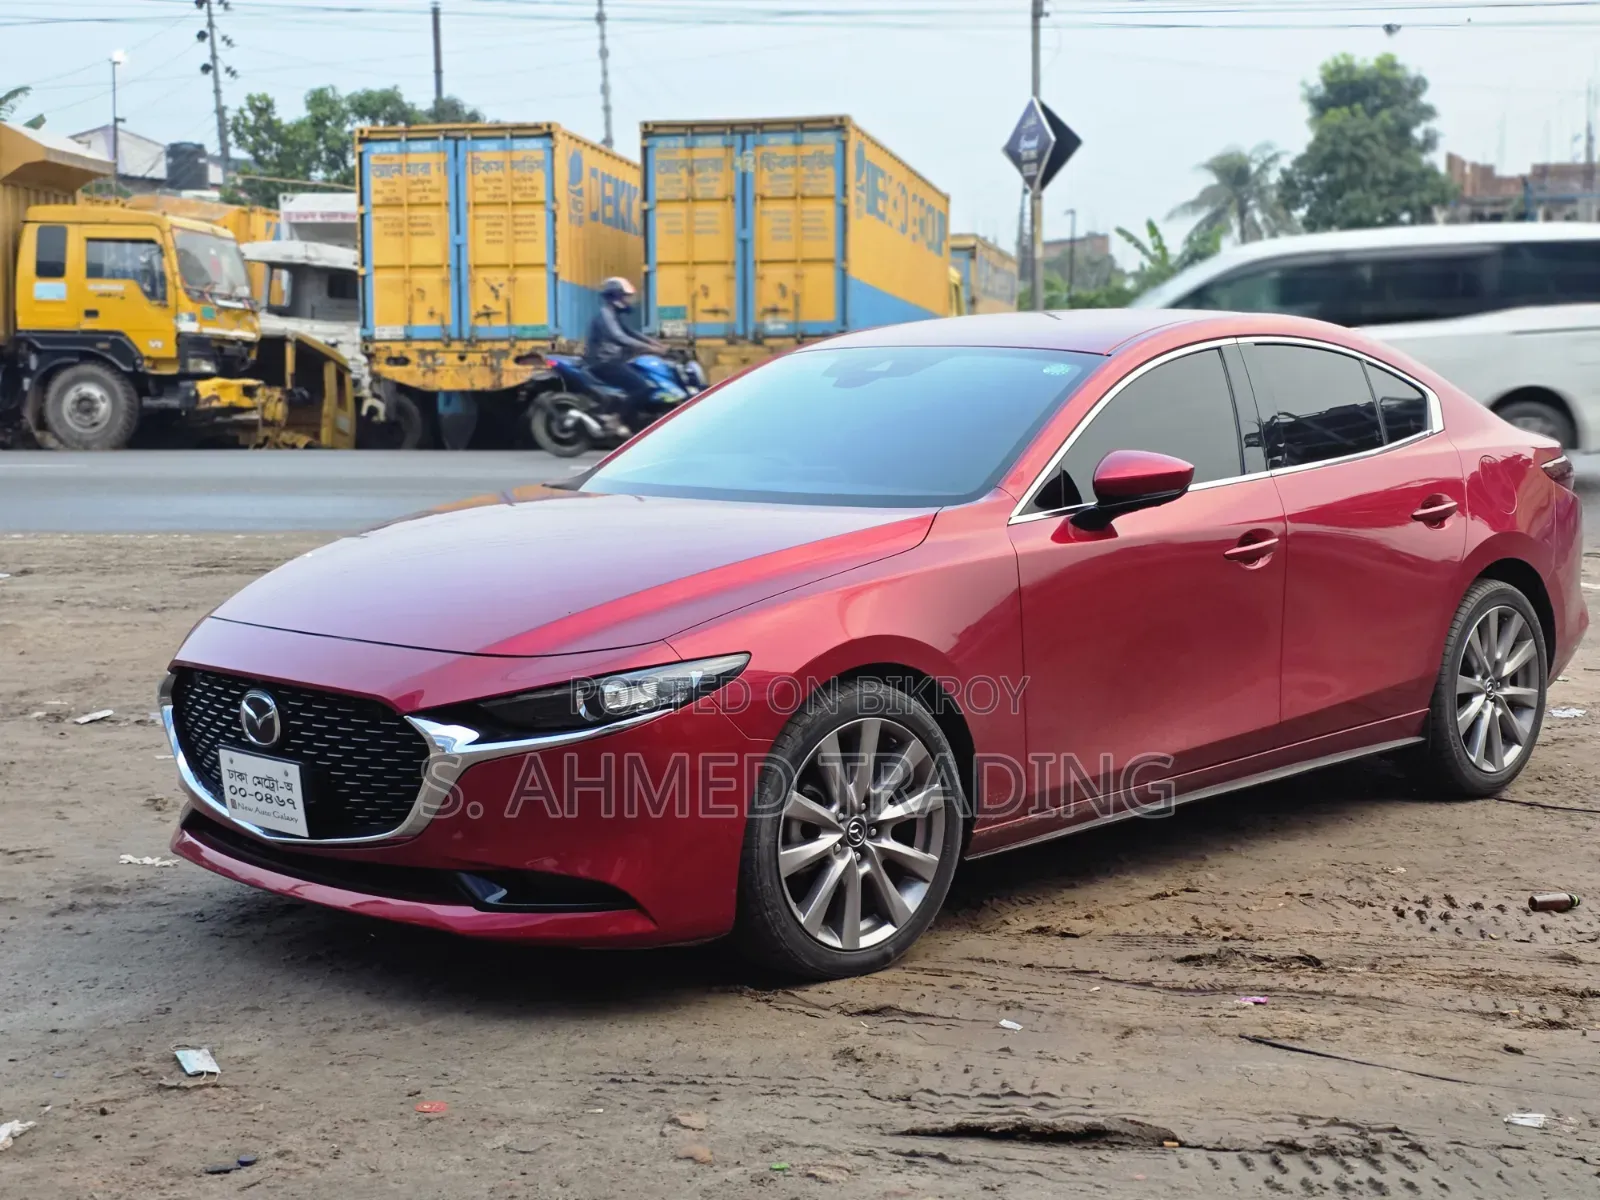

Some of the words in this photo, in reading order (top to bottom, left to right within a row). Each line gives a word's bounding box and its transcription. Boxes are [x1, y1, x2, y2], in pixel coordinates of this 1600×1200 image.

[589, 167, 643, 237] DEKK
[227, 769, 248, 784] ঢাকা
[229, 785, 297, 810] ০০-০৪৬৭
[237, 802, 254, 813] New
[254, 807, 272, 817] Auto
[272, 810, 299, 824] Galaxy
